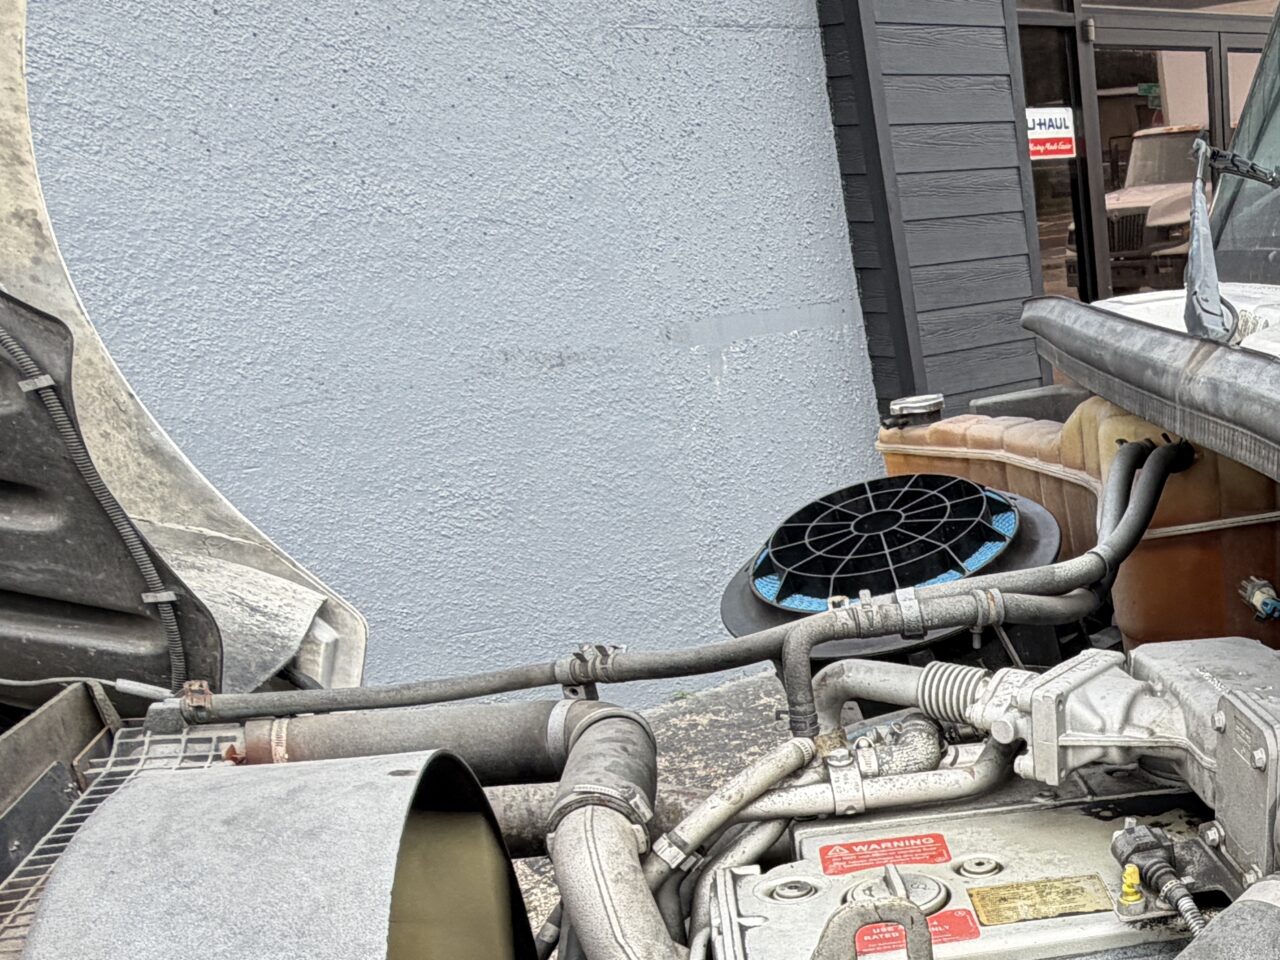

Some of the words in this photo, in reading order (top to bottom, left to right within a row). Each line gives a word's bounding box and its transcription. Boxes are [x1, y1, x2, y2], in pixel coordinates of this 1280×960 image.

[1027, 117, 1070, 130] U-HAUL
[852, 837, 935, 852] WARNING
[872, 926, 894, 934] USE
[864, 932, 899, 941] RATED
